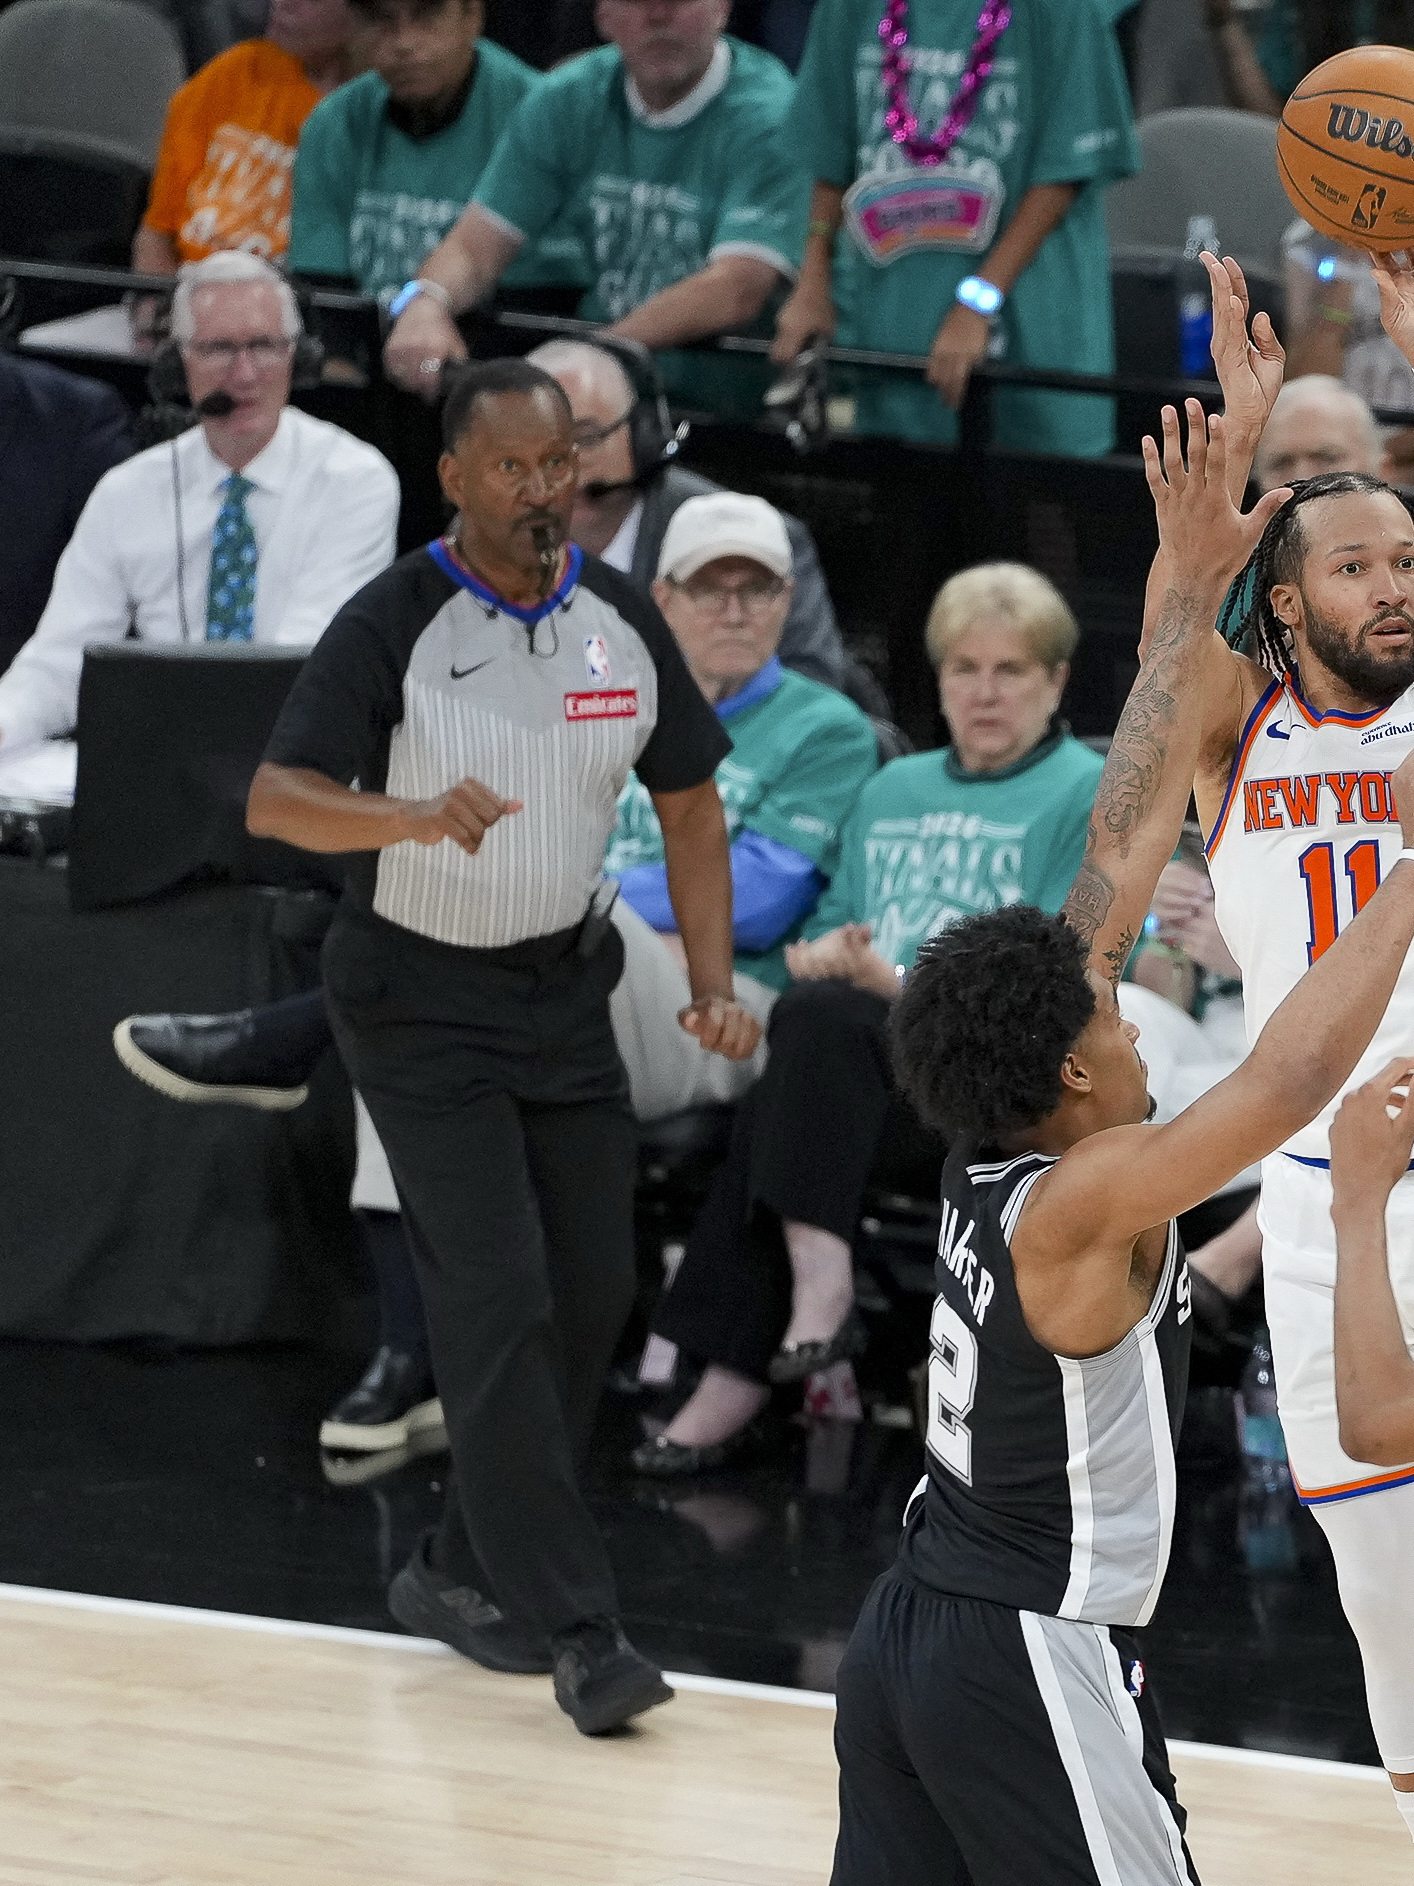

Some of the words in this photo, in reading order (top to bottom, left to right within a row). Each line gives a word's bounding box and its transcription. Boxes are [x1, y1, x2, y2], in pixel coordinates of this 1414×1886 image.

[565, 694, 638, 716] Emirates
[1360, 731, 1383, 746] abu
[1361, 721, 1392, 737] experience
[1244, 773, 1322, 833] NEW
[1325, 771, 1399, 824] YO
[1298, 838, 1382, 967] 11
[925, 1291, 979, 1488] 2
